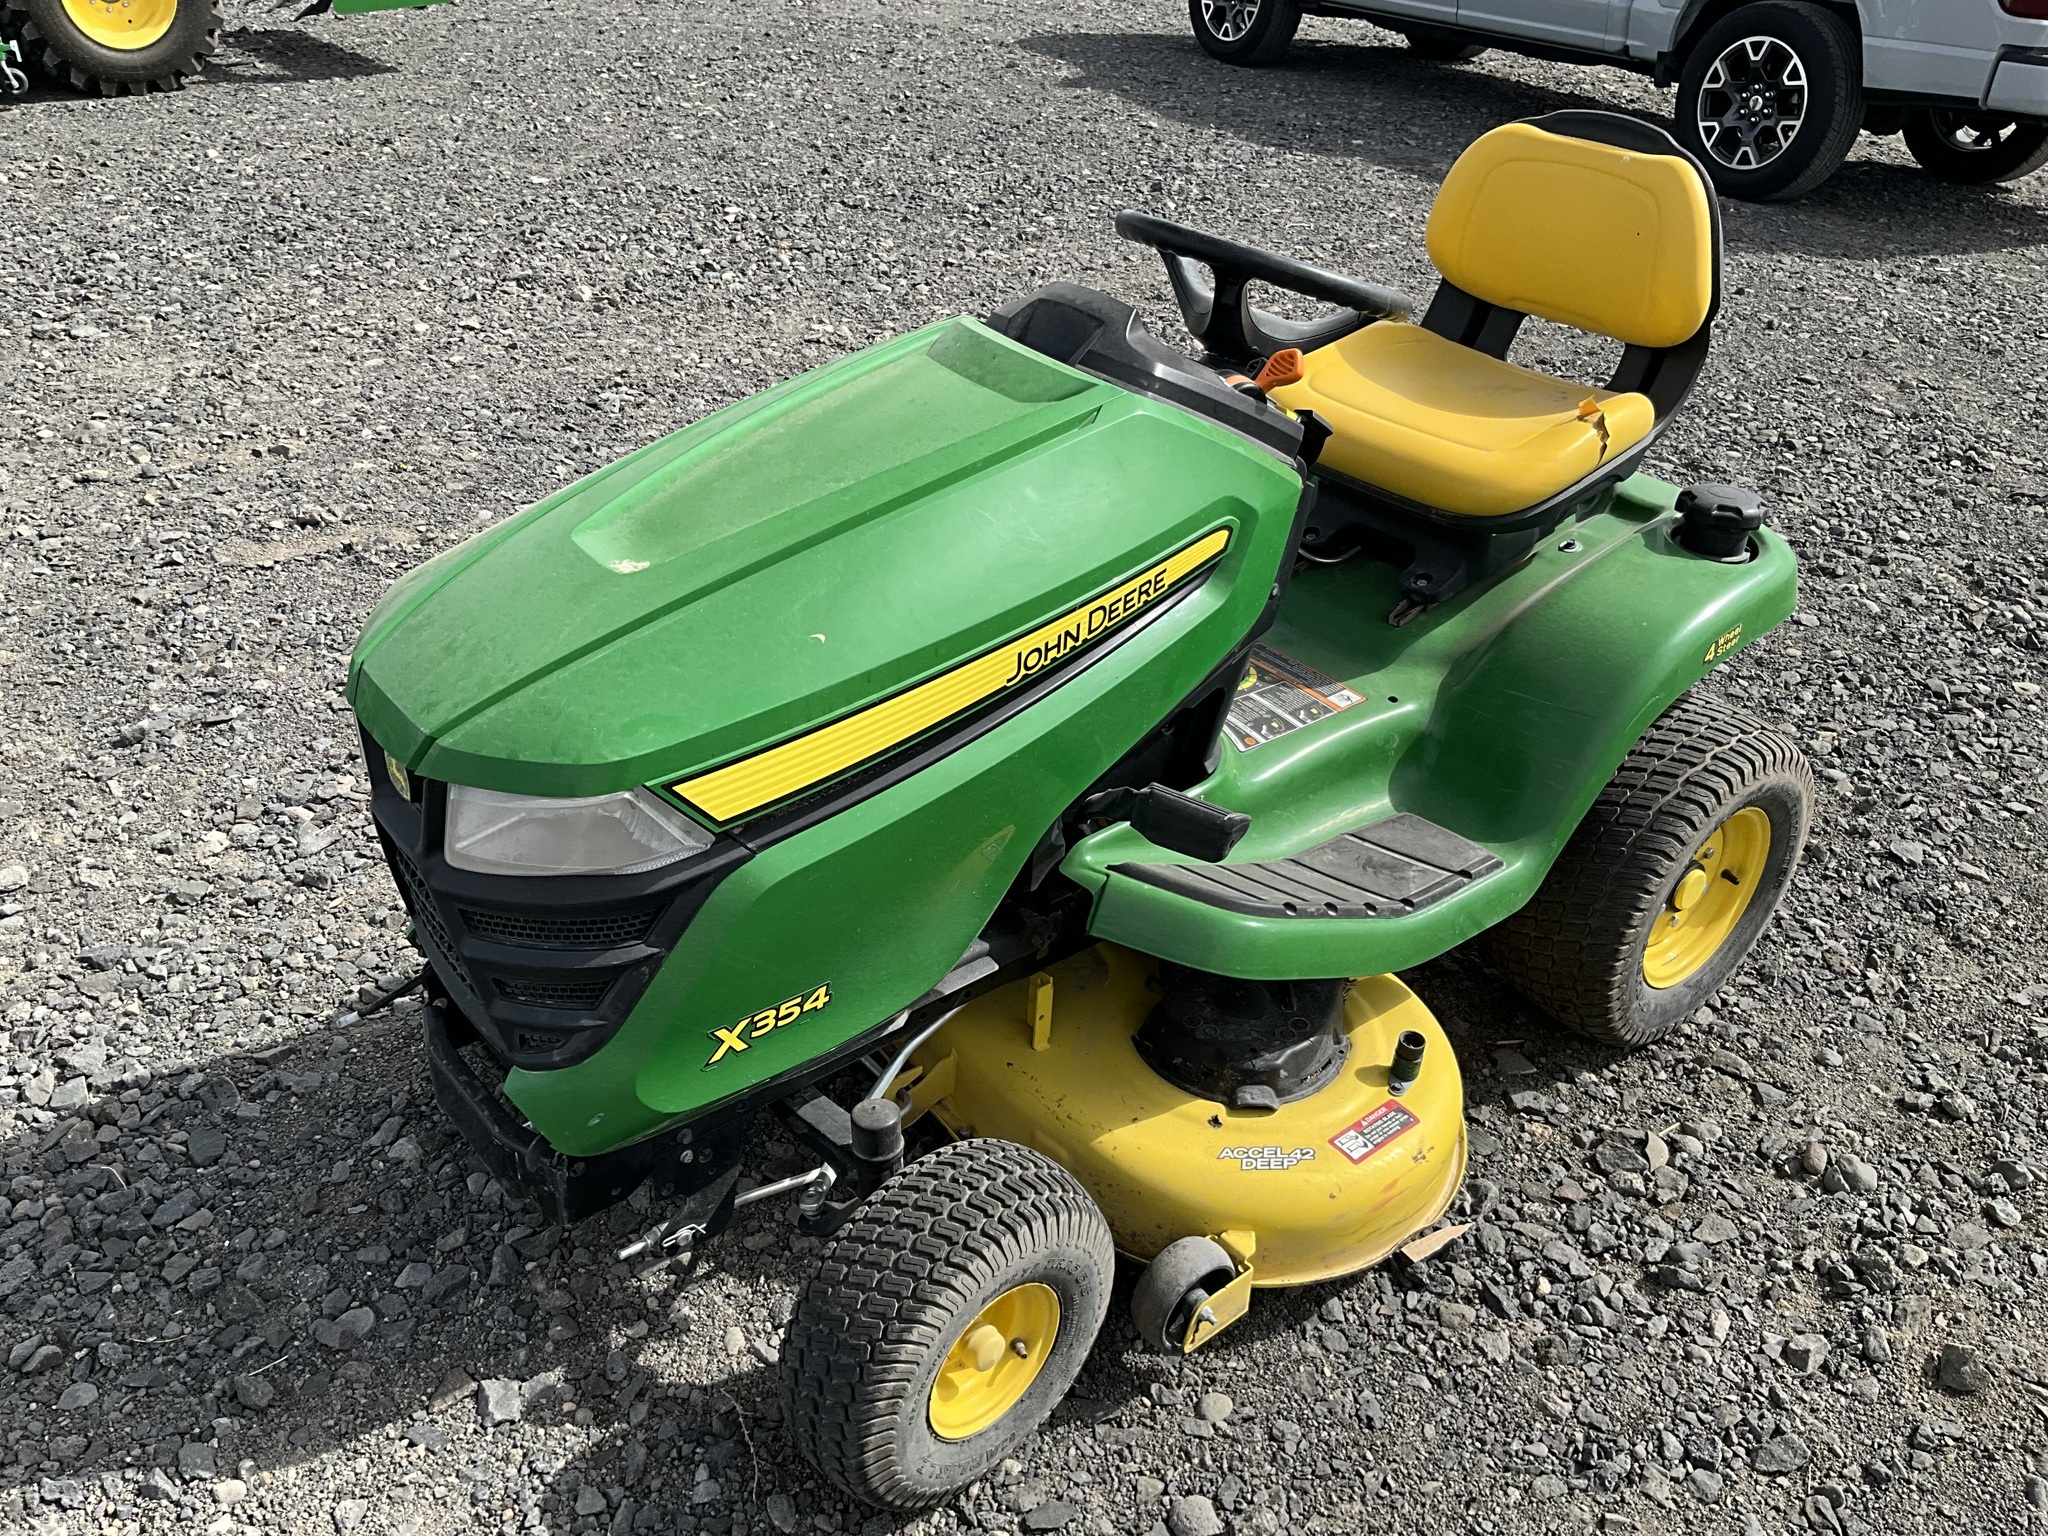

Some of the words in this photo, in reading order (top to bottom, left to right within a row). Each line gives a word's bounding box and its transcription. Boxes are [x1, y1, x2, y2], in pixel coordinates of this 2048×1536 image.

[1006, 622, 1081, 684] JOHN
[1086, 567, 1168, 636] DEERE
[1703, 642, 1716, 662] 4
[1718, 623, 1742, 647] Wheel
[1716, 635, 1740, 657] Steer
[705, 983, 831, 1066] X354
[1241, 1158, 1299, 1171] DEEP
